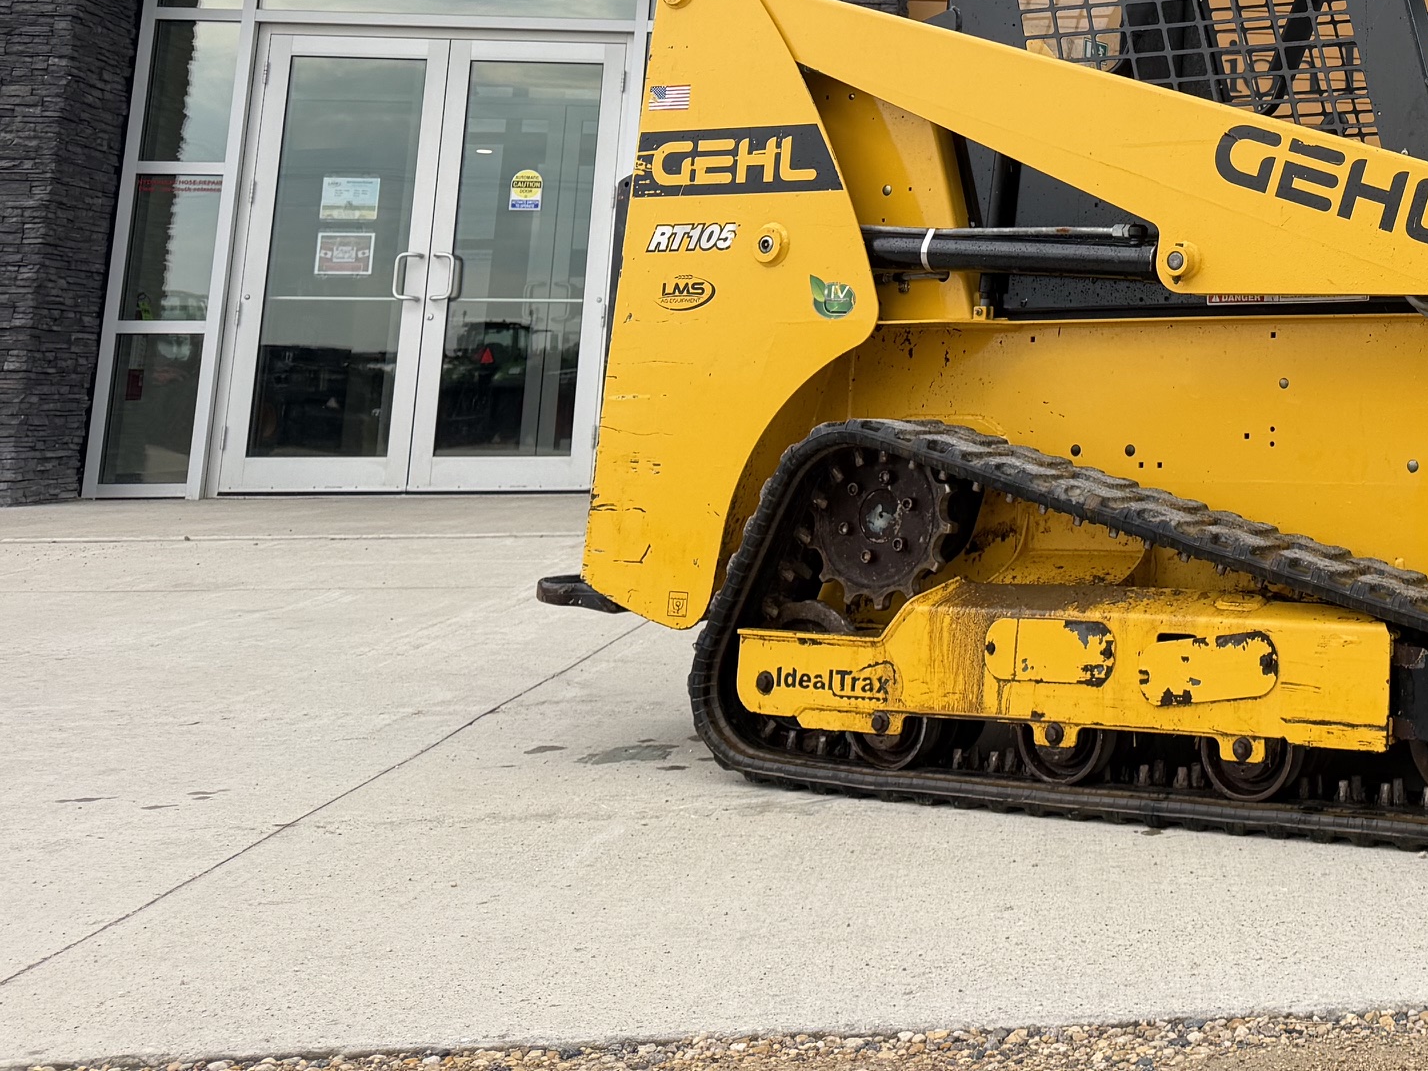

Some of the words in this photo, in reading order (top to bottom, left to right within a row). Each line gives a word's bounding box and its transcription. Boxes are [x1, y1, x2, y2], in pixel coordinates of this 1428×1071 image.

[652, 135, 818, 187] GEHL
[646, 222, 738, 252] RT105
[661, 281, 706, 297] LMS
